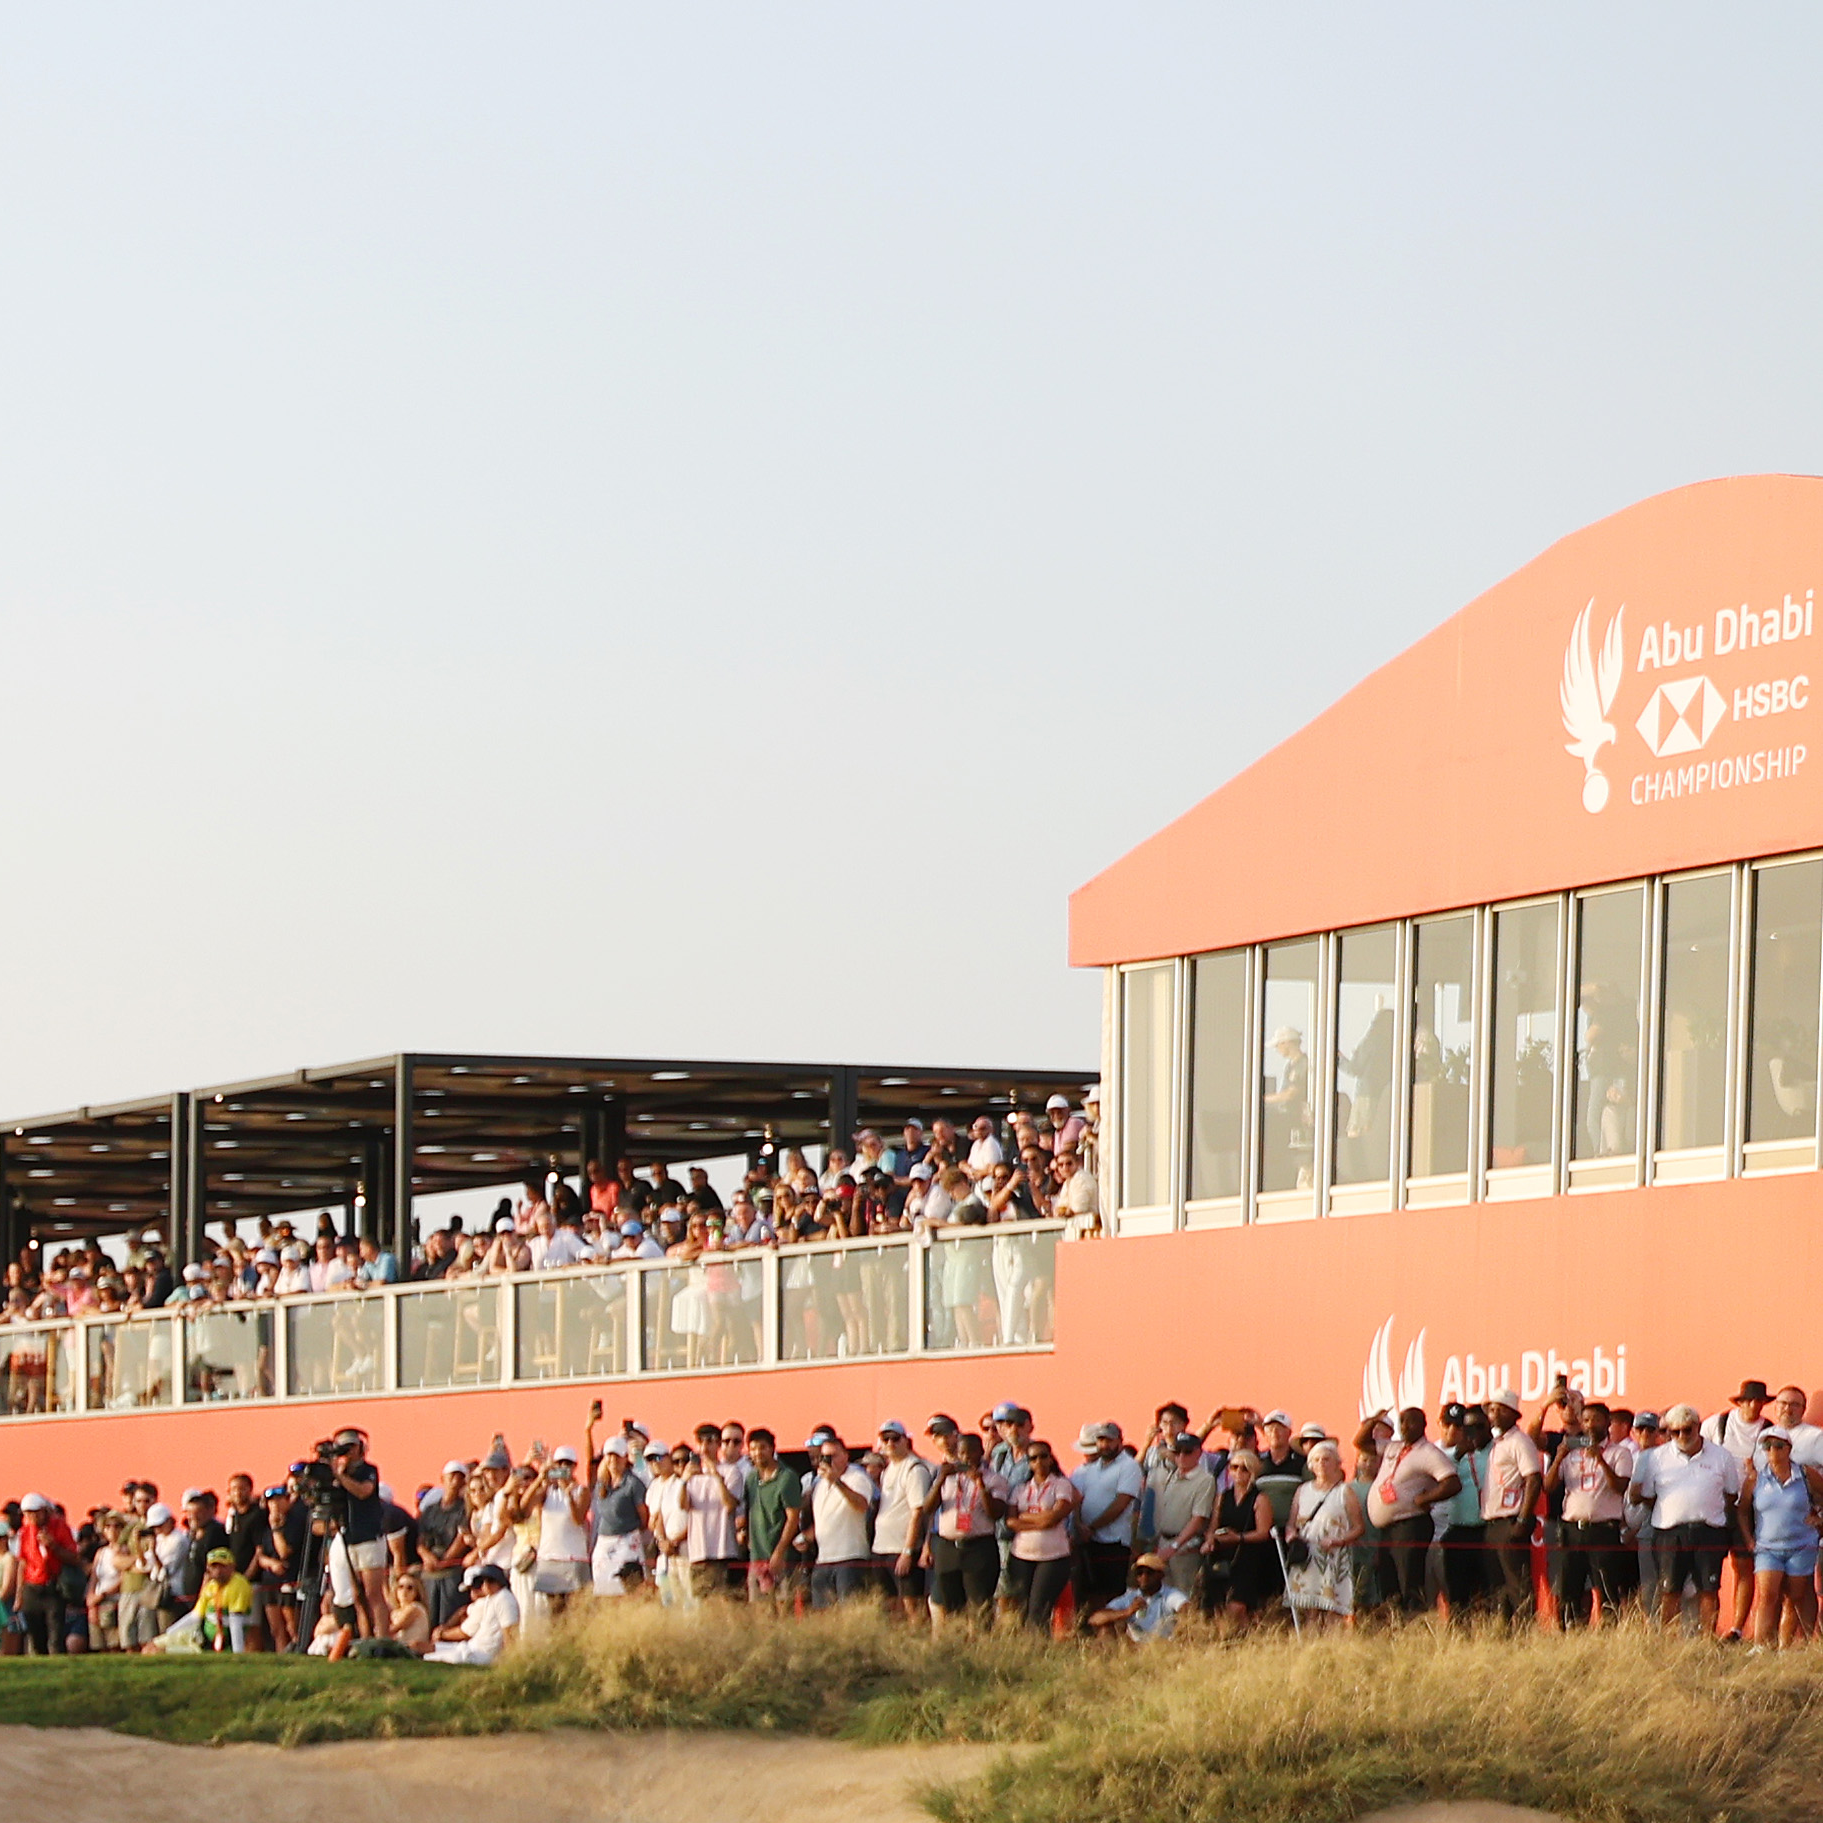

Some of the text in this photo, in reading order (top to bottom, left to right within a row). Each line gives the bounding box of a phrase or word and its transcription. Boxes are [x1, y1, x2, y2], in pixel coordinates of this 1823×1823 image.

[1637, 588, 1814, 672] Abu Dhabi
[1733, 674, 1809, 722] HSBC
[1630, 744, 1807, 806] CHAMPIONSHIP
[1439, 1343, 1626, 1404] Abu Dhabi
